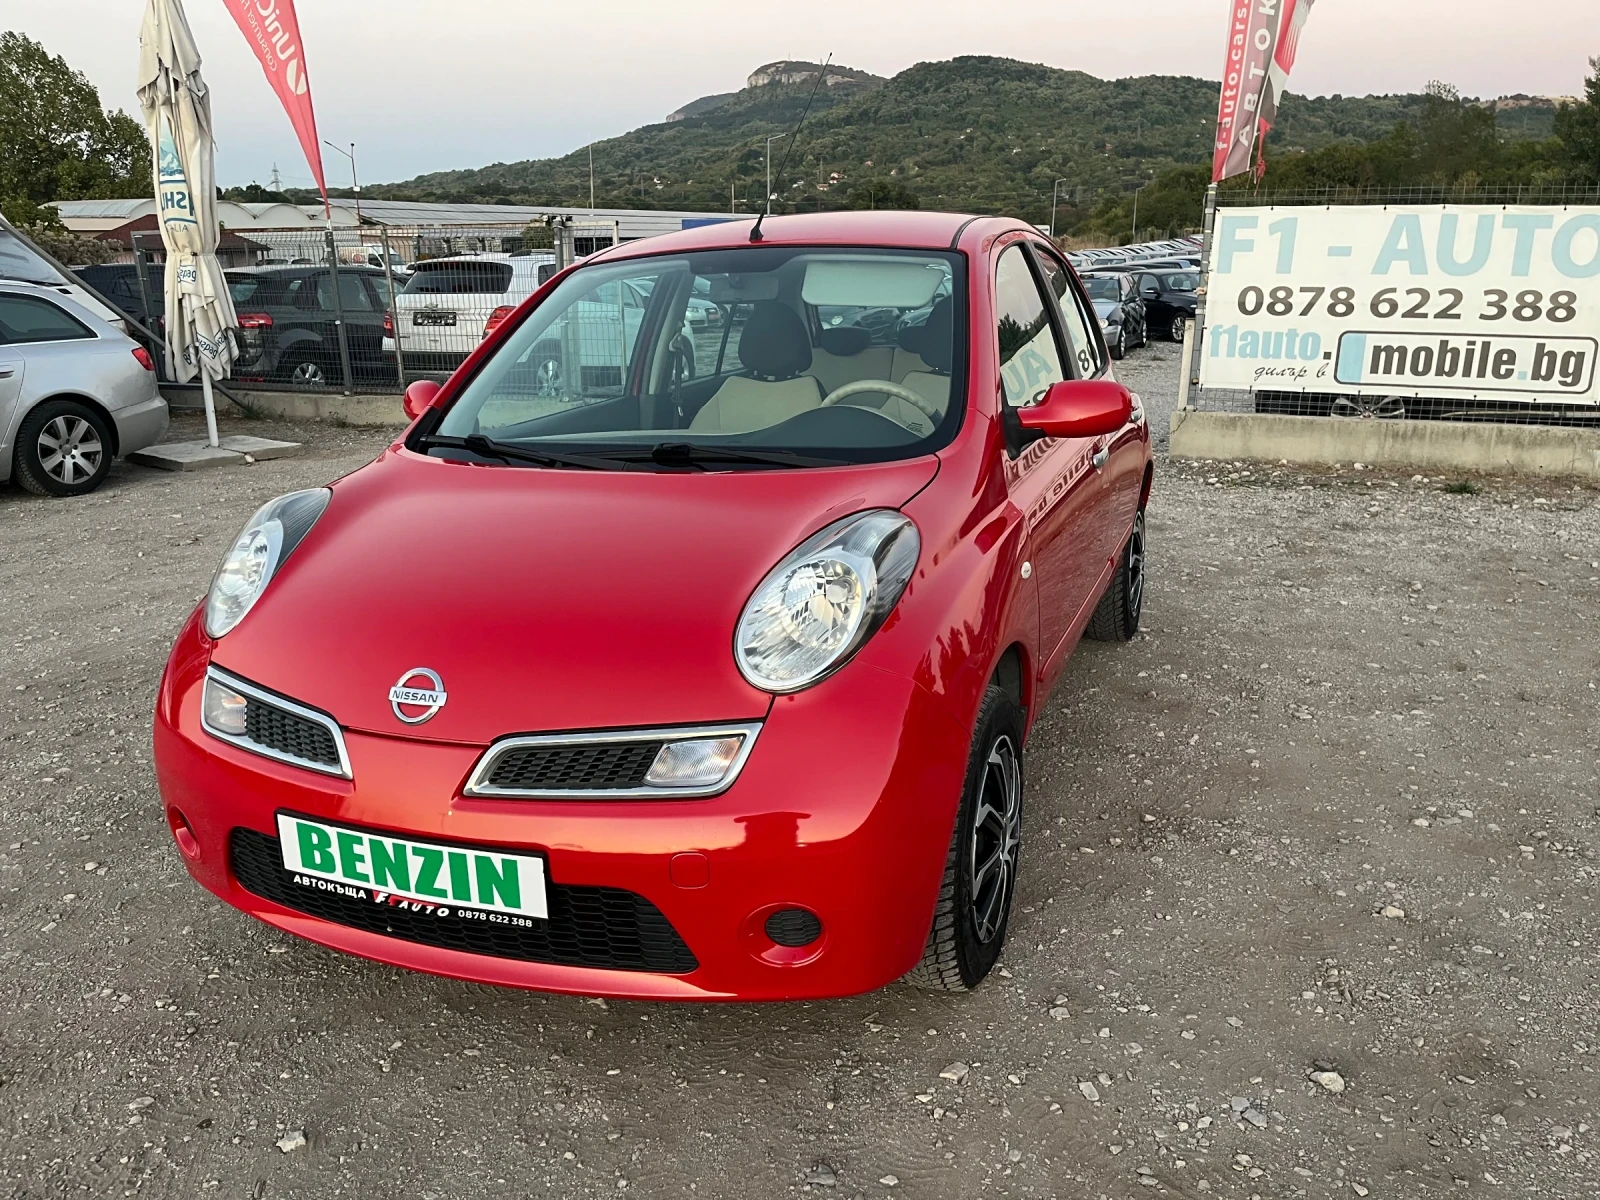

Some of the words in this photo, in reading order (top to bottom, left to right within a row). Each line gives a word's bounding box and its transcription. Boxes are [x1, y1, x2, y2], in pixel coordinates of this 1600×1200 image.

[1216, 215, 1299, 275] F1
[1371, 213, 1600, 279] AUTO
[1237, 285, 1356, 318] 0878
[1369, 287, 1464, 320] 622
[1478, 289, 1578, 323] 388
[1369, 339, 1586, 388] mobile.bg
[391, 689, 439, 704] NISSAN
[295, 821, 522, 910] BENZIN
[293, 874, 367, 900] АВТОКЪЩА
[398, 900, 450, 917] AUTO
[457, 909, 487, 921] 0878
[488, 913, 510, 924] 622
[511, 917, 533, 928] 388
